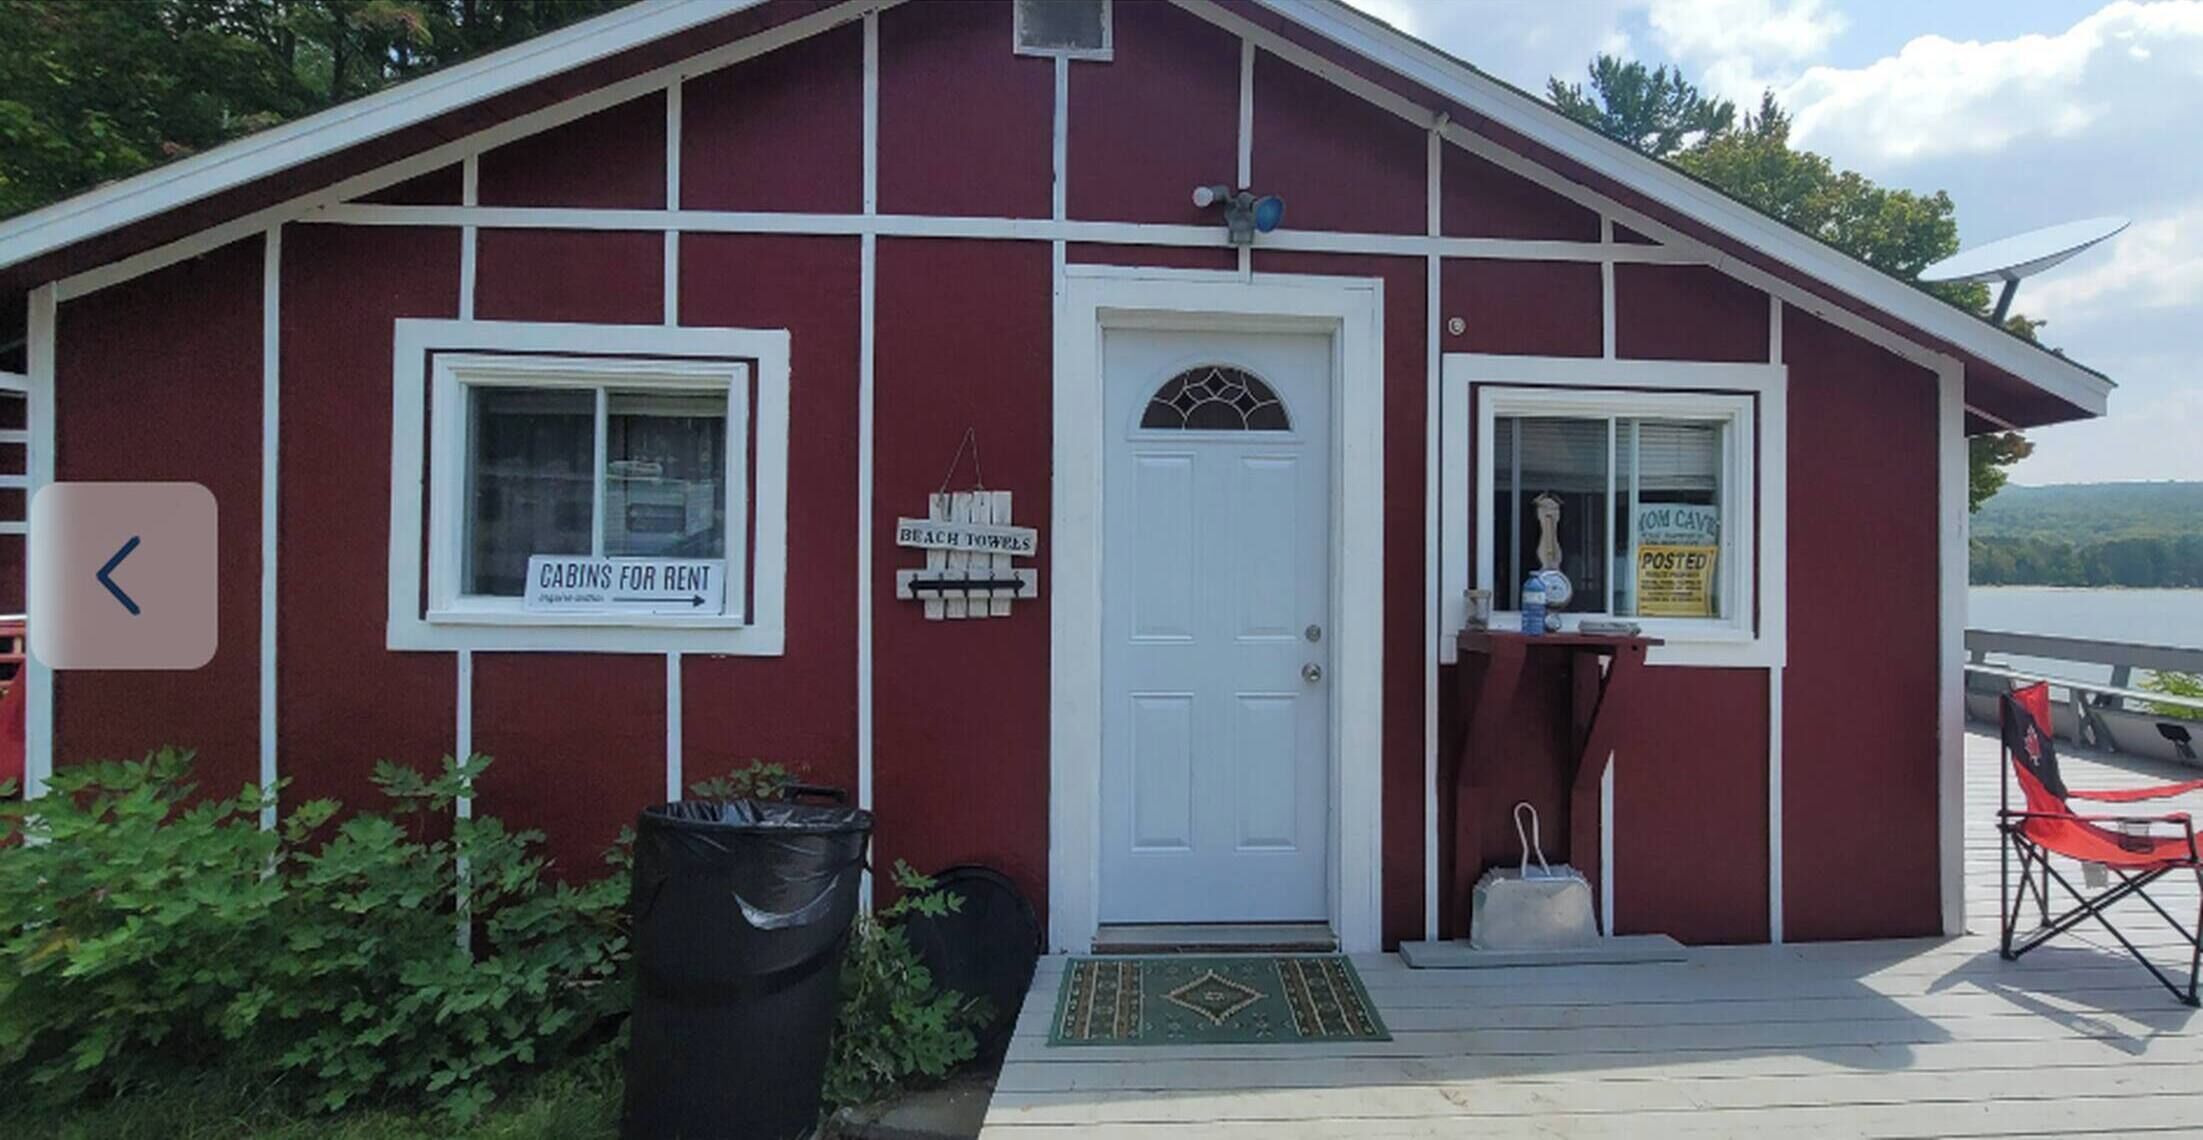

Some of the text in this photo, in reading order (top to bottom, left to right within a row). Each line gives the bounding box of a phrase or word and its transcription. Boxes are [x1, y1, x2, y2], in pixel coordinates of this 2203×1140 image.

[900, 528, 1031, 551] BEACH TOWELS
[1641, 552, 1707, 570] POSTED
[540, 563, 710, 591] CABINS FOR RENT
